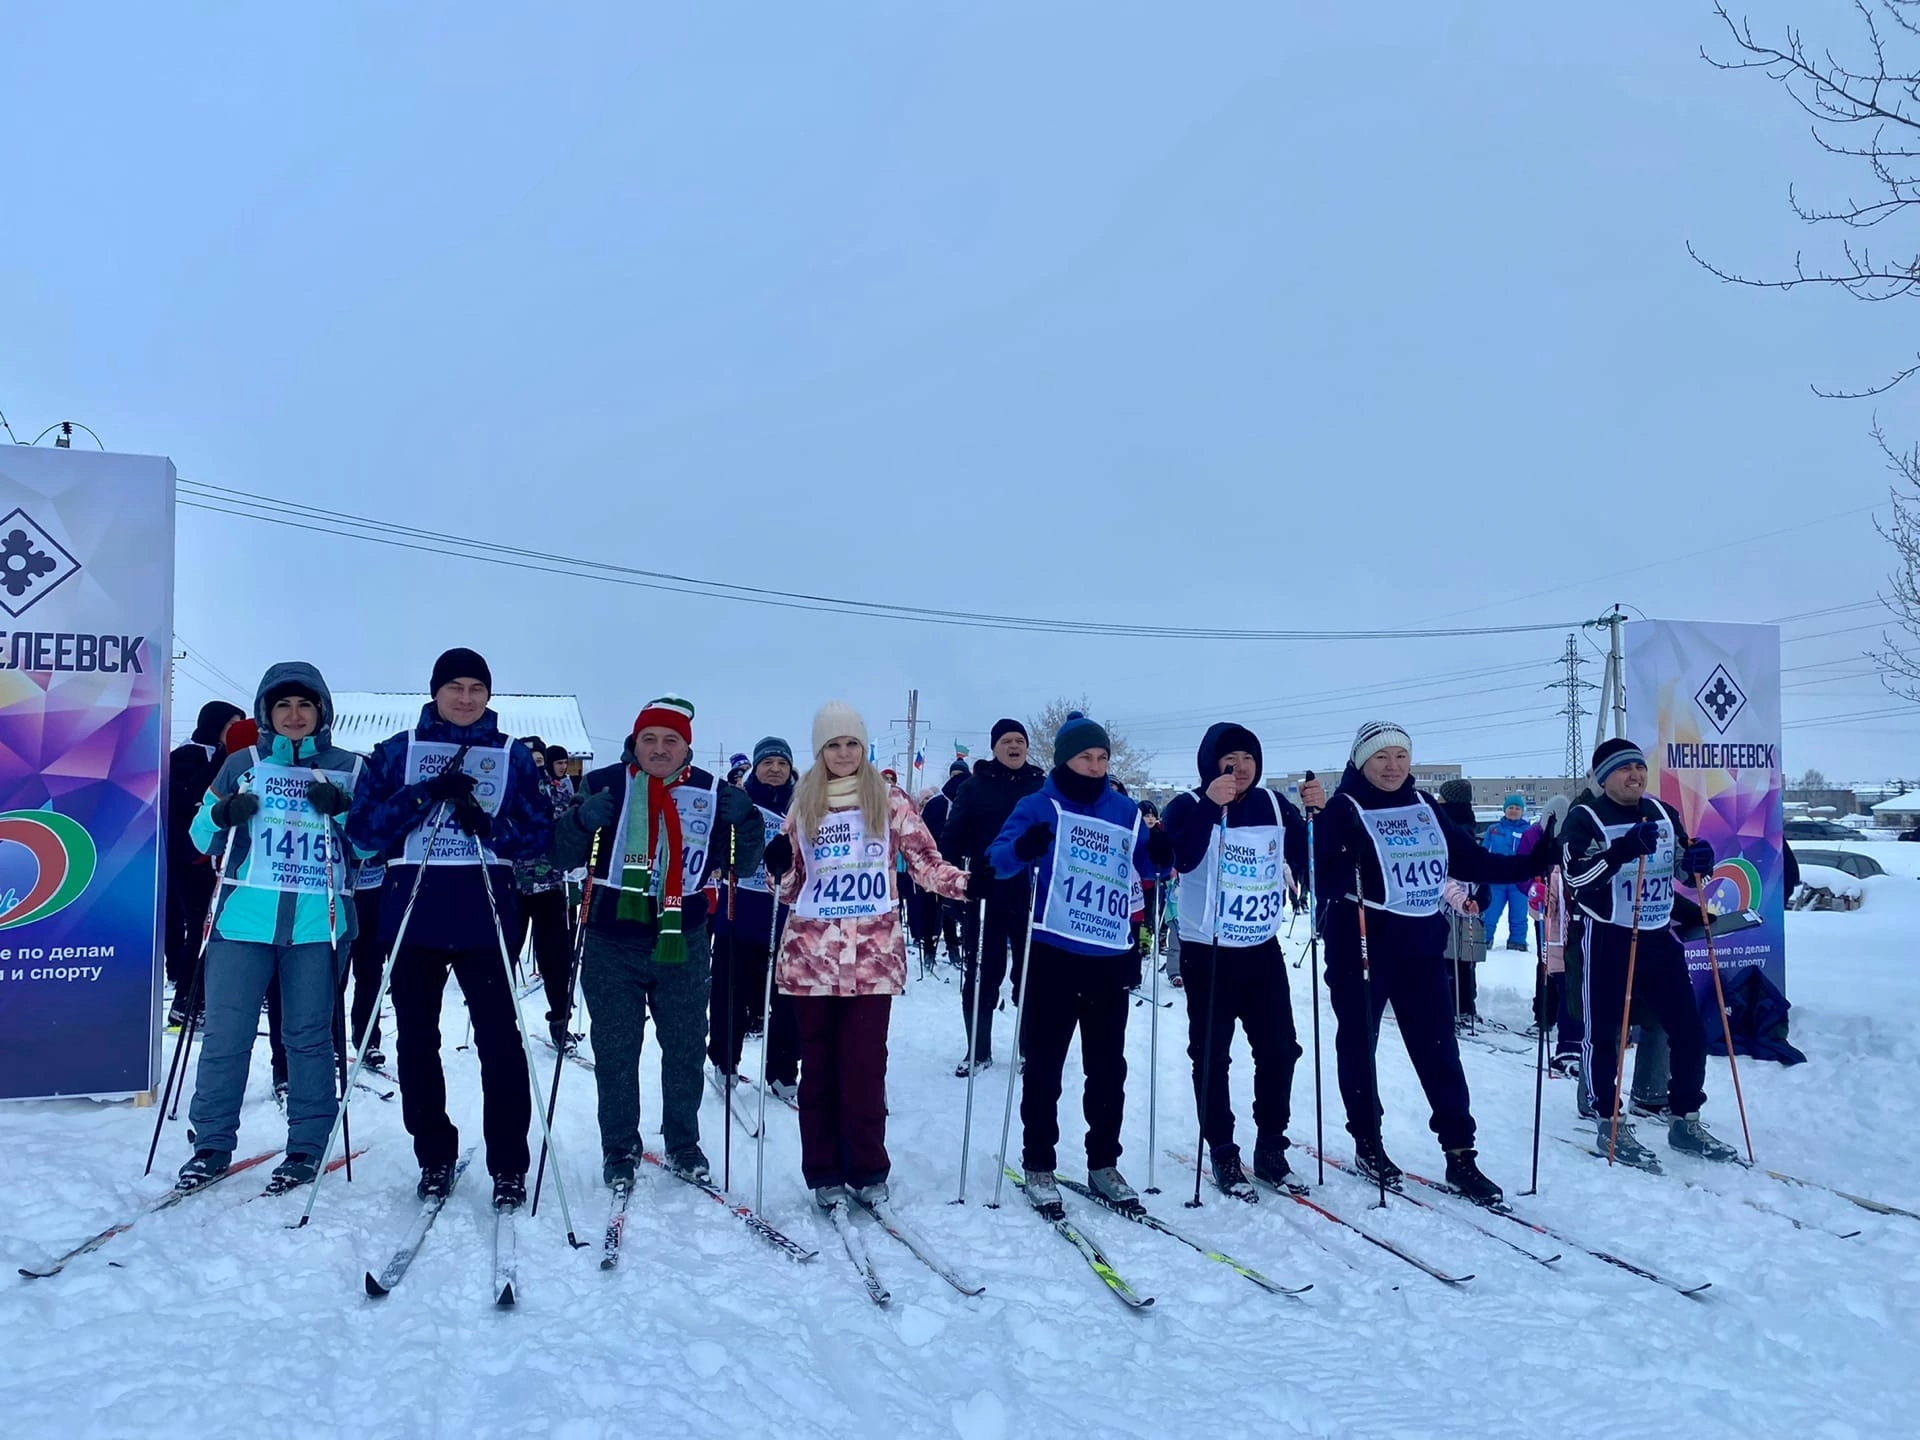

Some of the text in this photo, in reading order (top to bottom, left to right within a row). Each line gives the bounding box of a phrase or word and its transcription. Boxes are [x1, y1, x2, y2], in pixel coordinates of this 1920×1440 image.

[1667, 743, 1775, 768] МЕНДЕЛЕЕВСК
[264, 796, 309, 813] 2022
[815, 823, 850, 836] ЫЖНЯ
[1070, 825, 1110, 844] ЛЫЖНЯ
[260, 827, 341, 864] 14153
[814, 844, 851, 861] 2022
[1070, 835, 1109, 855] РОССИИ
[1070, 846, 1108, 867] 2022
[1224, 851, 1257, 865] ОССИИ
[271, 861, 329, 877] РЕСПУБЛИК
[1392, 858, 1447, 888] 1419
[813, 871, 886, 903] 14200
[1063, 876, 1129, 920] 14160
[1219, 891, 1280, 922] 14233
[818, 904, 877, 917] РЕСПУБЛИКА
[1068, 908, 1121, 931] РЕСПУБЛИКА
[1070, 919, 1118, 941] ТАТАРСТАН
[18, 947, 44, 960] по
[48, 945, 115, 962] делам
[1732, 946, 1744, 955] по
[1744, 944, 1771, 955] делам
[1730, 960, 1737, 968] и
[11, 968, 24, 981] и
[30, 965, 103, 983] спорту
